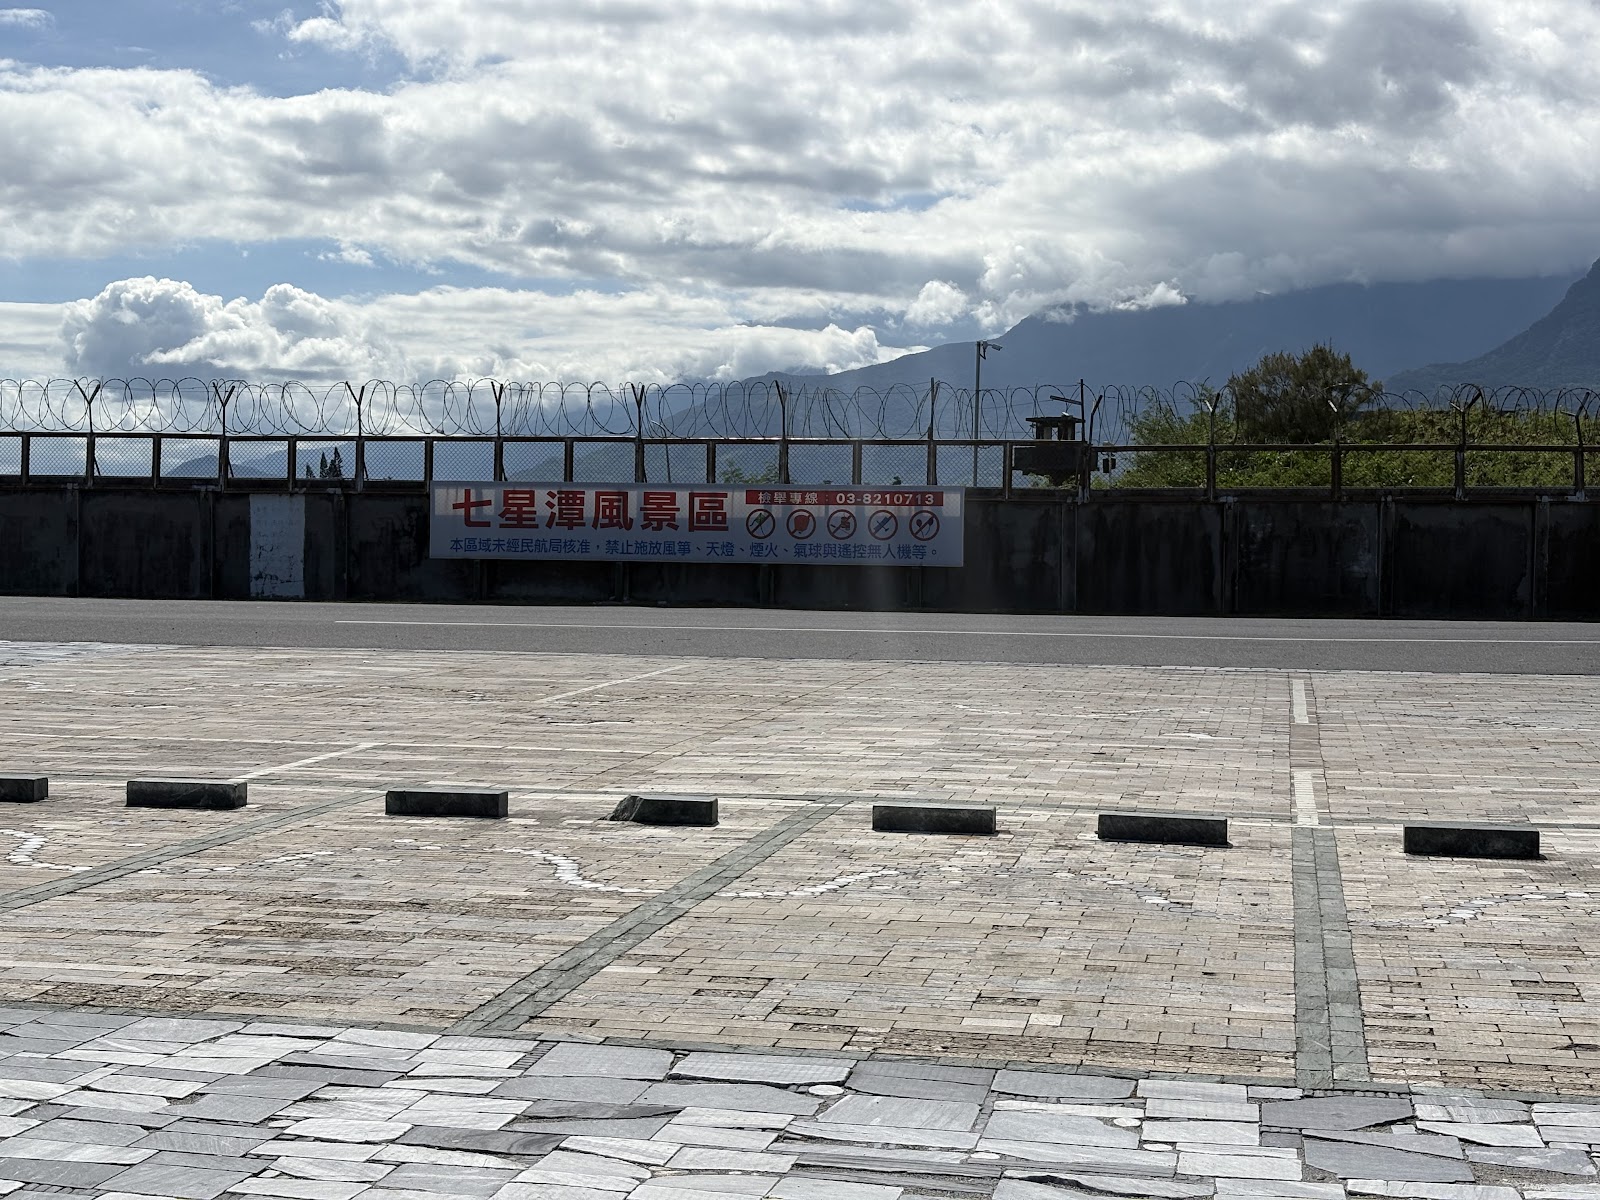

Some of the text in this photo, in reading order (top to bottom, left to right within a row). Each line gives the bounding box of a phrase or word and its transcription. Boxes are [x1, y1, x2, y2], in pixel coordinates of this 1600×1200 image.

[451, 488, 729, 532] 七星潭風景區
